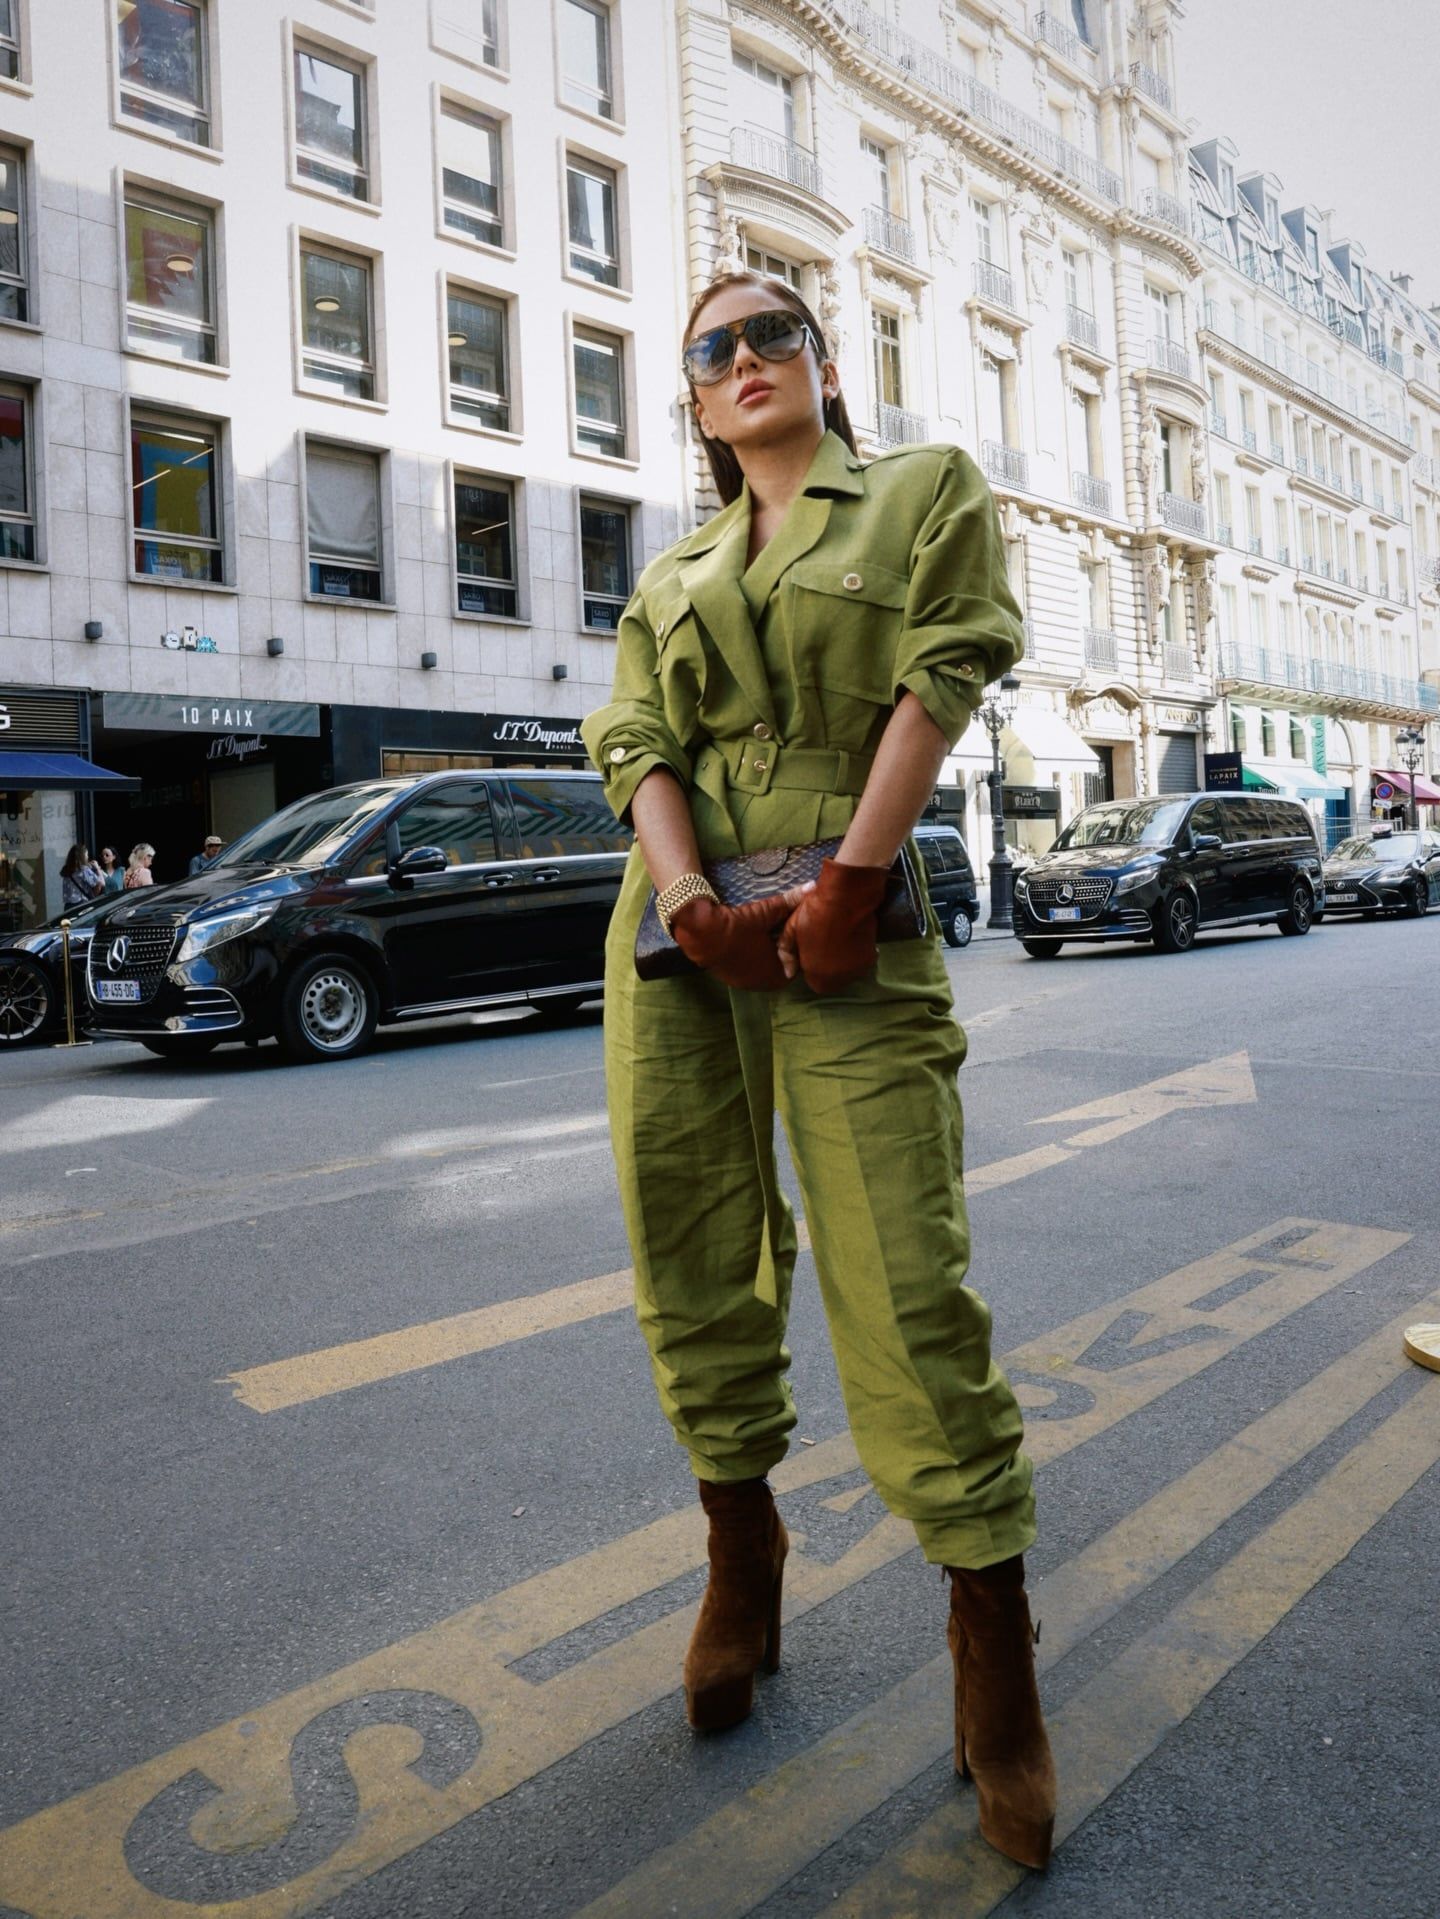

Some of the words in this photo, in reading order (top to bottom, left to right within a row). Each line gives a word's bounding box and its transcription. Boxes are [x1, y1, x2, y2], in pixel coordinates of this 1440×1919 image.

[181, 707, 199, 724] 10
[212, 708, 253, 727] PAIX
[225, 734, 267, 761] Dupont
[522, 721, 584, 750] Dupont
